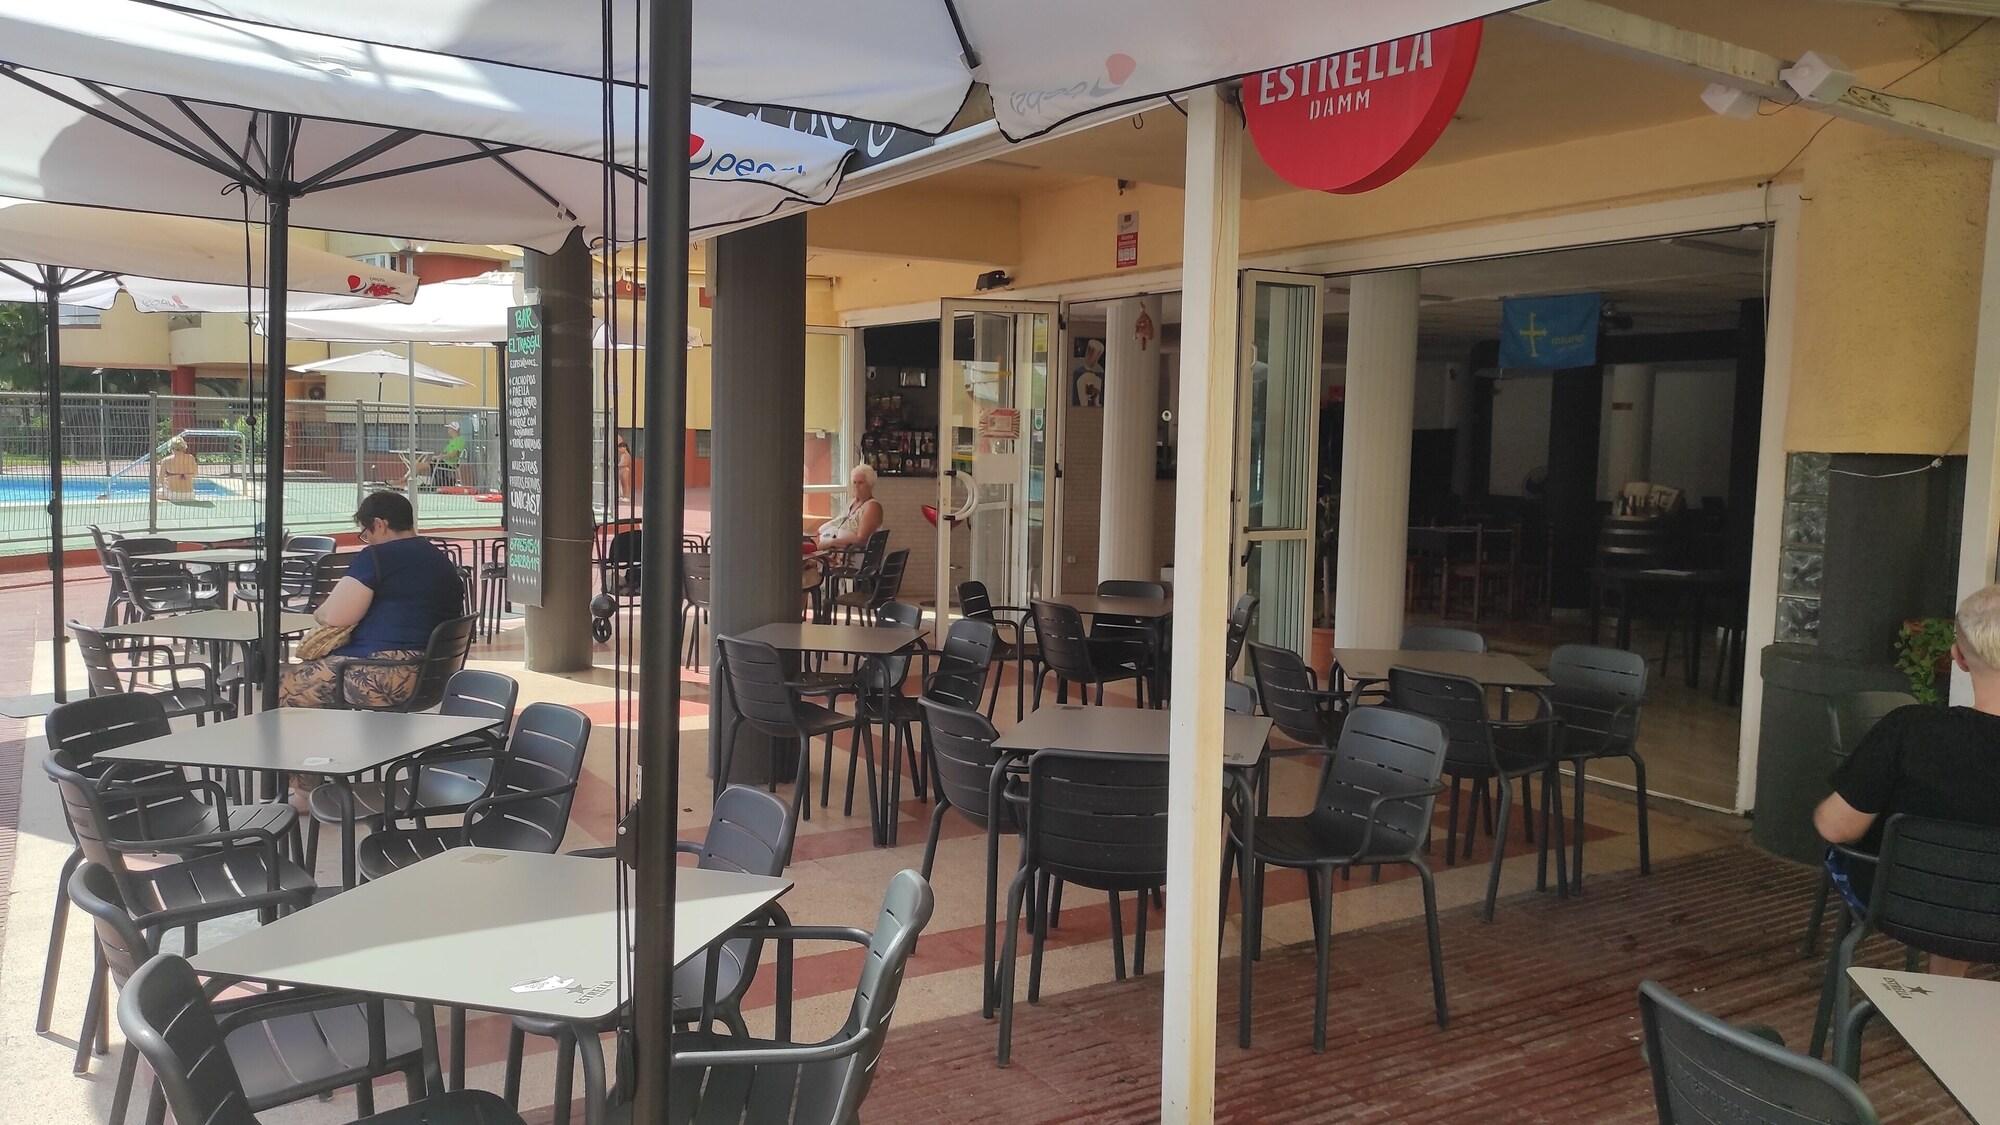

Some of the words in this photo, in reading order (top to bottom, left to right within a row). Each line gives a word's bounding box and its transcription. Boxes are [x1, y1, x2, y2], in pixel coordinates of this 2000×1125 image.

[1260, 32, 1433, 106] ESTRELLA
[1310, 89, 1370, 120] DAMM
[515, 307, 538, 328] BAR
[509, 337, 517, 352] EL
[516, 335, 540, 354] TRASGU
[512, 374, 536, 385] CACHOPOS
[512, 385, 530, 396] PAELLA
[527, 414, 536, 426] CON
[512, 460, 538, 474] NUESTRAS
